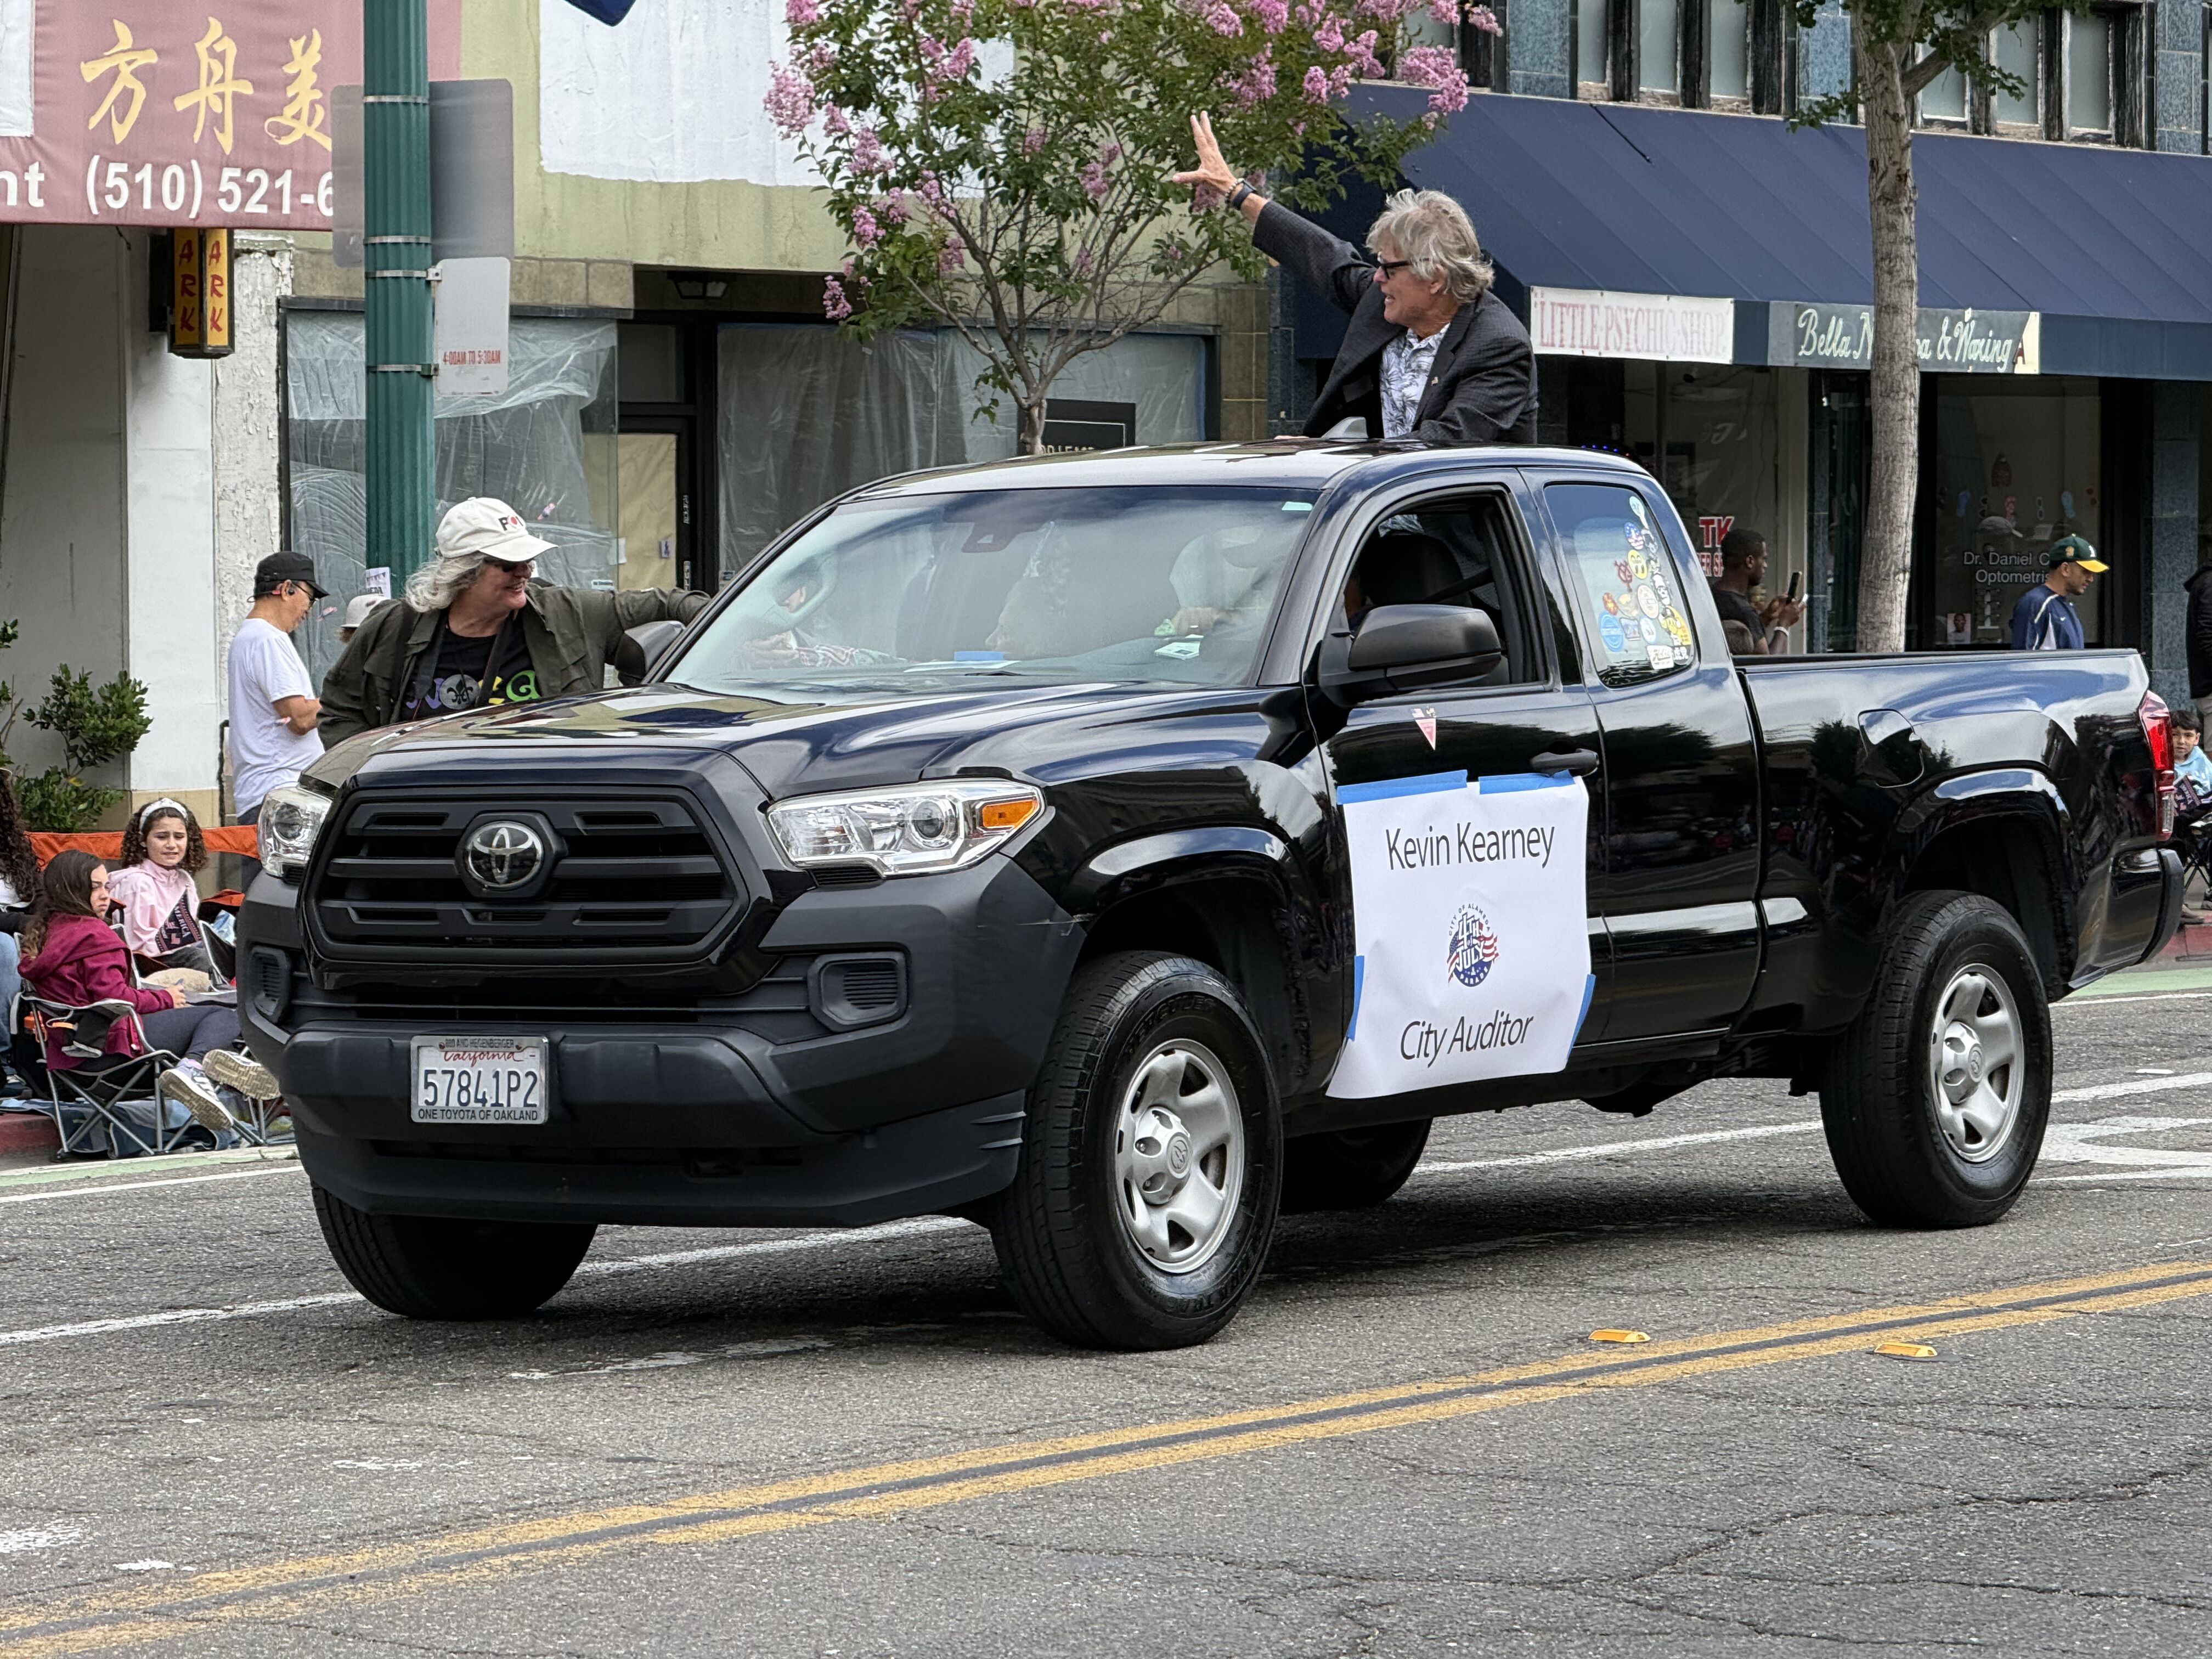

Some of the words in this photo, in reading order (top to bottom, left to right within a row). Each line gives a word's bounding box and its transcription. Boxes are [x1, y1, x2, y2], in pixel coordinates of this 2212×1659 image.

[86, 155, 202, 218] (510)
[1798, 308, 1851, 358] Bella
[1937, 317, 1951, 361] &
[1954, 320, 2013, 373] Waxing
[1963, 552, 1982, 565] Dr.
[1989, 551, 2032, 565] Daniel
[1386, 825, 1450, 870] Kevin
[1457, 822, 1555, 868] Kearney
[1448, 915, 1457, 936] CITY
[1458, 904, 1465, 913] OF
[1468, 903, 1491, 932] ALAMEDA
[1458, 911, 1480, 950] 4TH
[1455, 940, 1486, 973] JULY
[1460, 966, 1488, 985] PARADE
[1400, 1020, 1447, 1068] City
[1448, 1009, 1534, 1054] Auditor
[444, 1051, 524, 1068] California
[424, 1070, 538, 1108] 57841P2
[418, 1108, 437, 1120] ONE
[441, 1109, 476, 1120] TOYOTA
[479, 1109, 491, 1120] OF
[494, 1109, 538, 1121] OAKLAND
